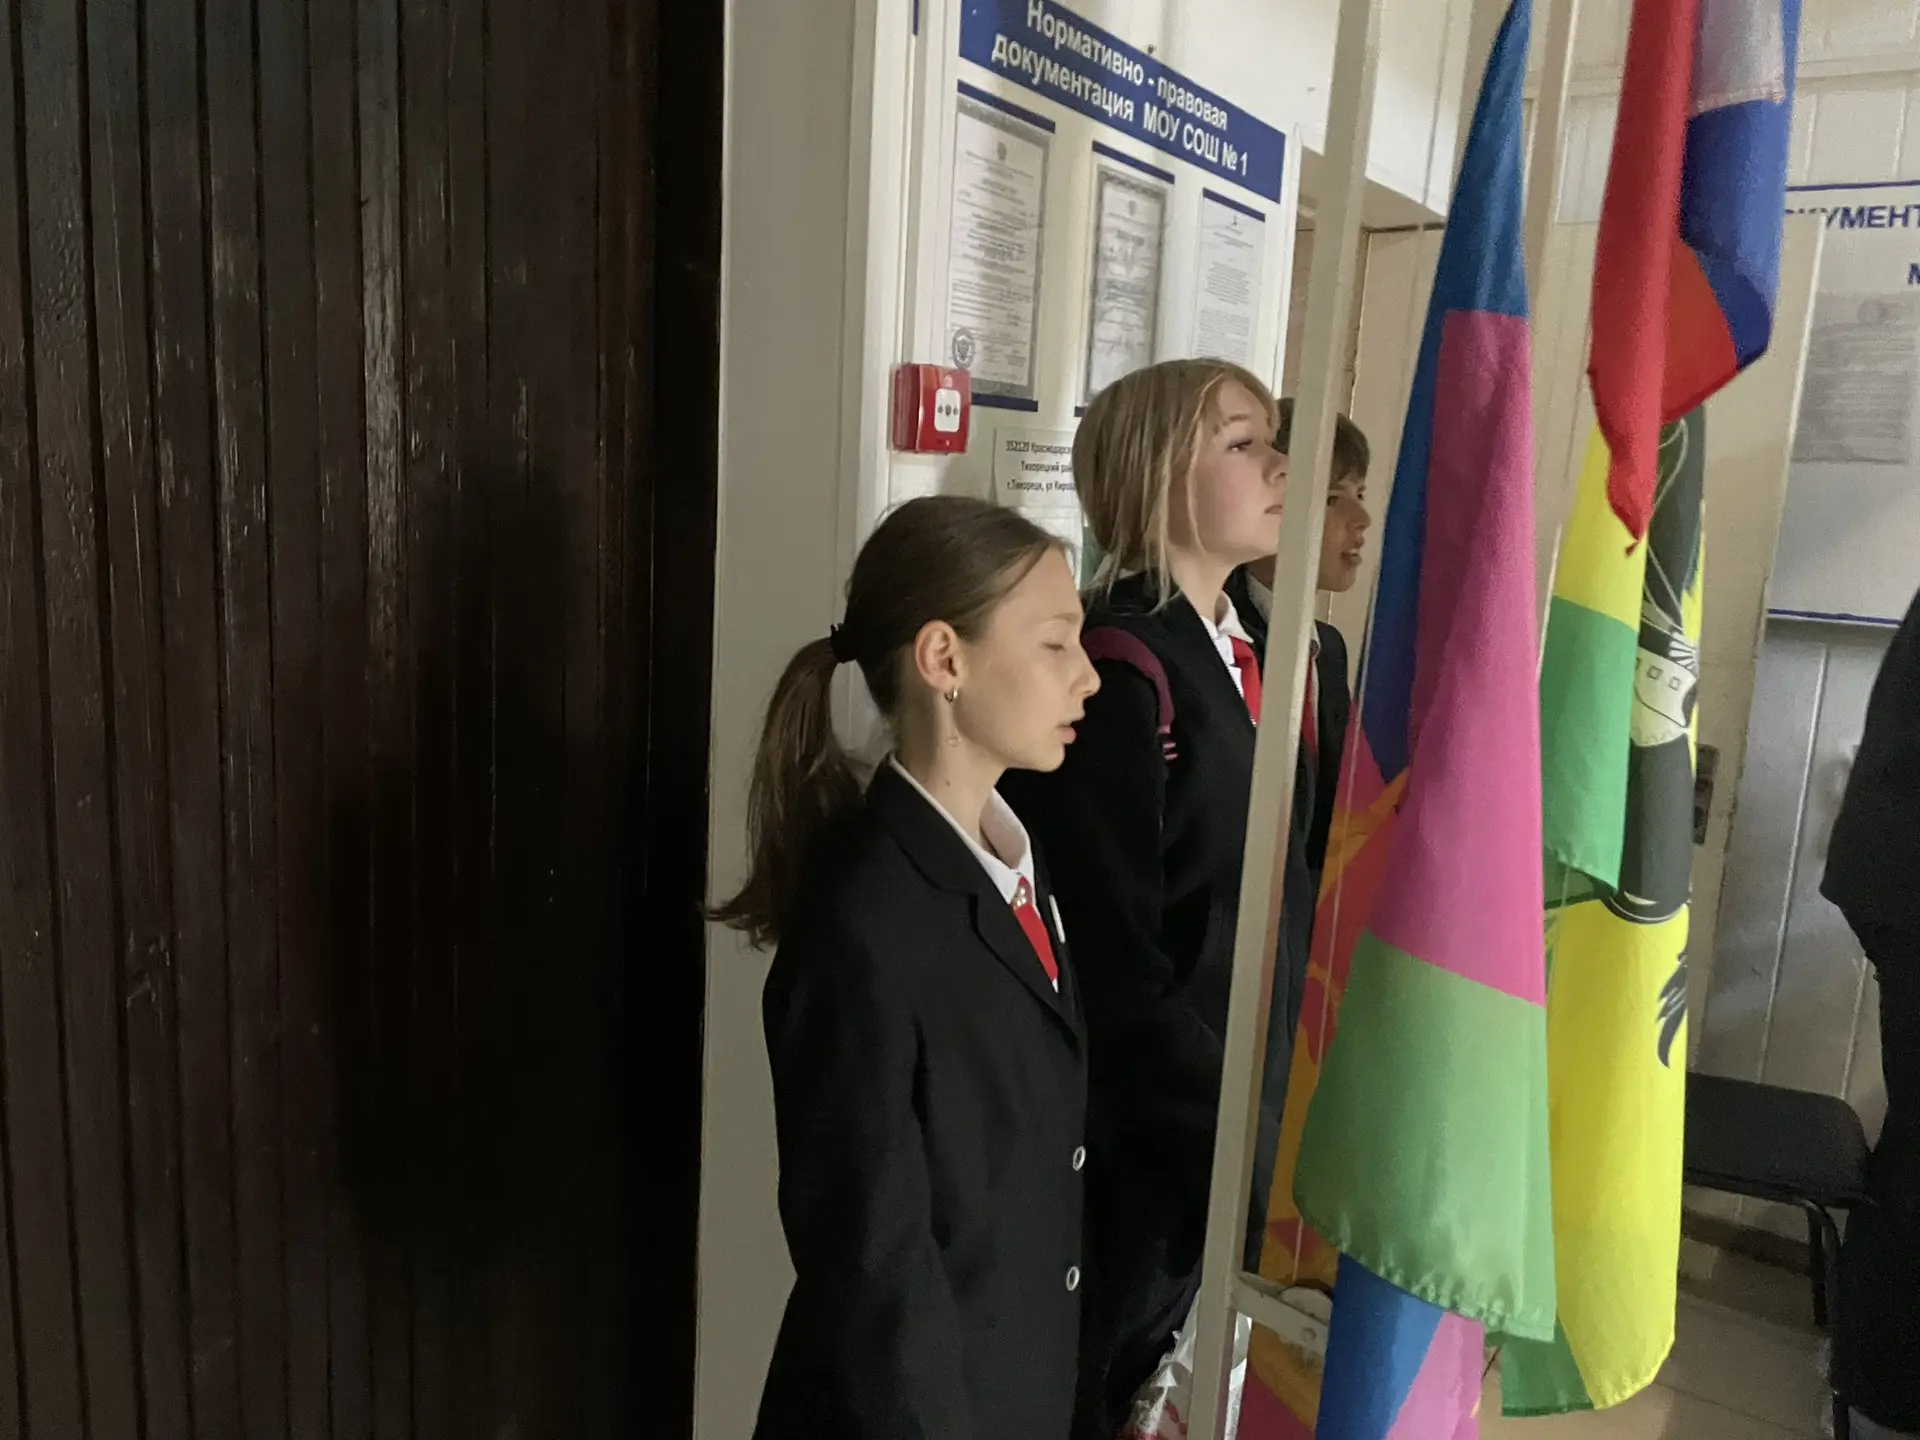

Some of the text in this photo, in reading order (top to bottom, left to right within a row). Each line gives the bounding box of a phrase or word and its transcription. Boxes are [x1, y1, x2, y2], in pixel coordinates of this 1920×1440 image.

[991, 33, 1248, 177] документация МОУ СОШ № 1
[1027, 0, 1145, 86] Нормативно
[1157, 76, 1228, 132] правовая
